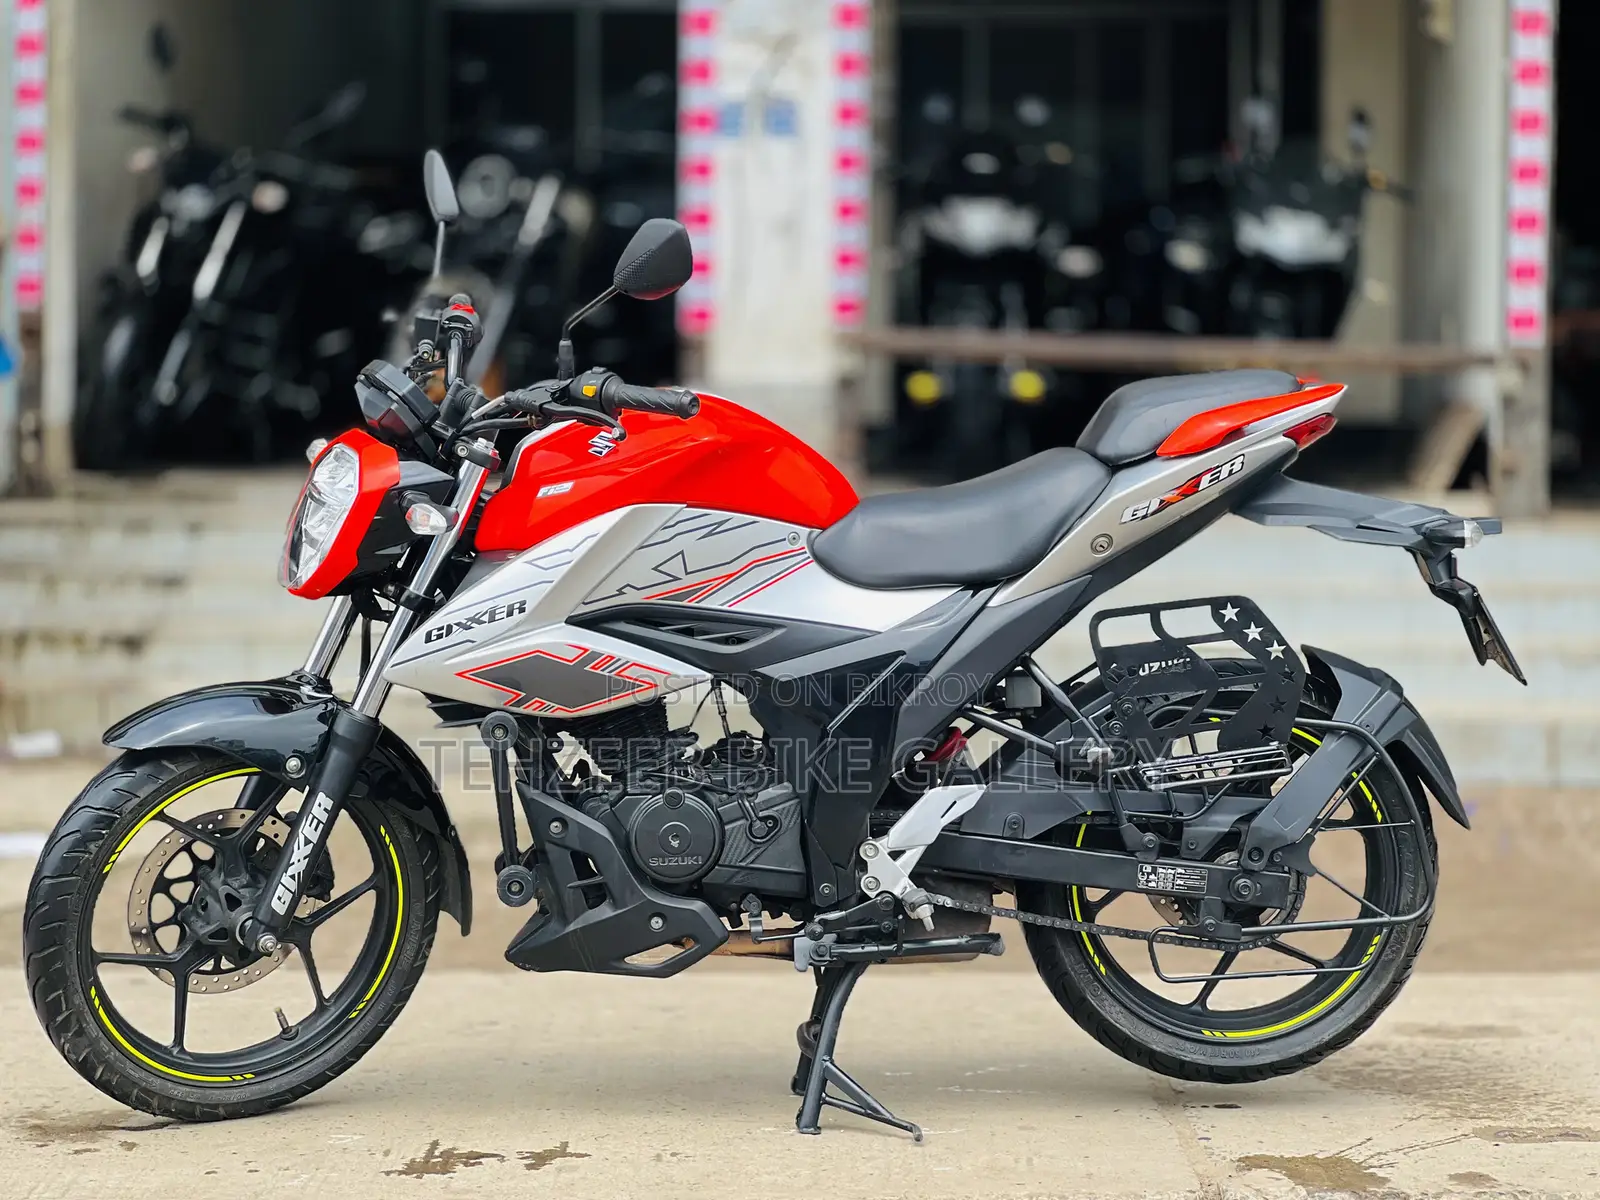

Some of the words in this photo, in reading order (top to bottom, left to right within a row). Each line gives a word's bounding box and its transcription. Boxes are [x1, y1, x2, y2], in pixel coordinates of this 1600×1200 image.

[1119, 454, 1246, 524] GIXXER
[424, 599, 527, 644] GIXXER
[271, 791, 334, 916] GIXXER
[648, 855, 703, 867] SUZUKI
